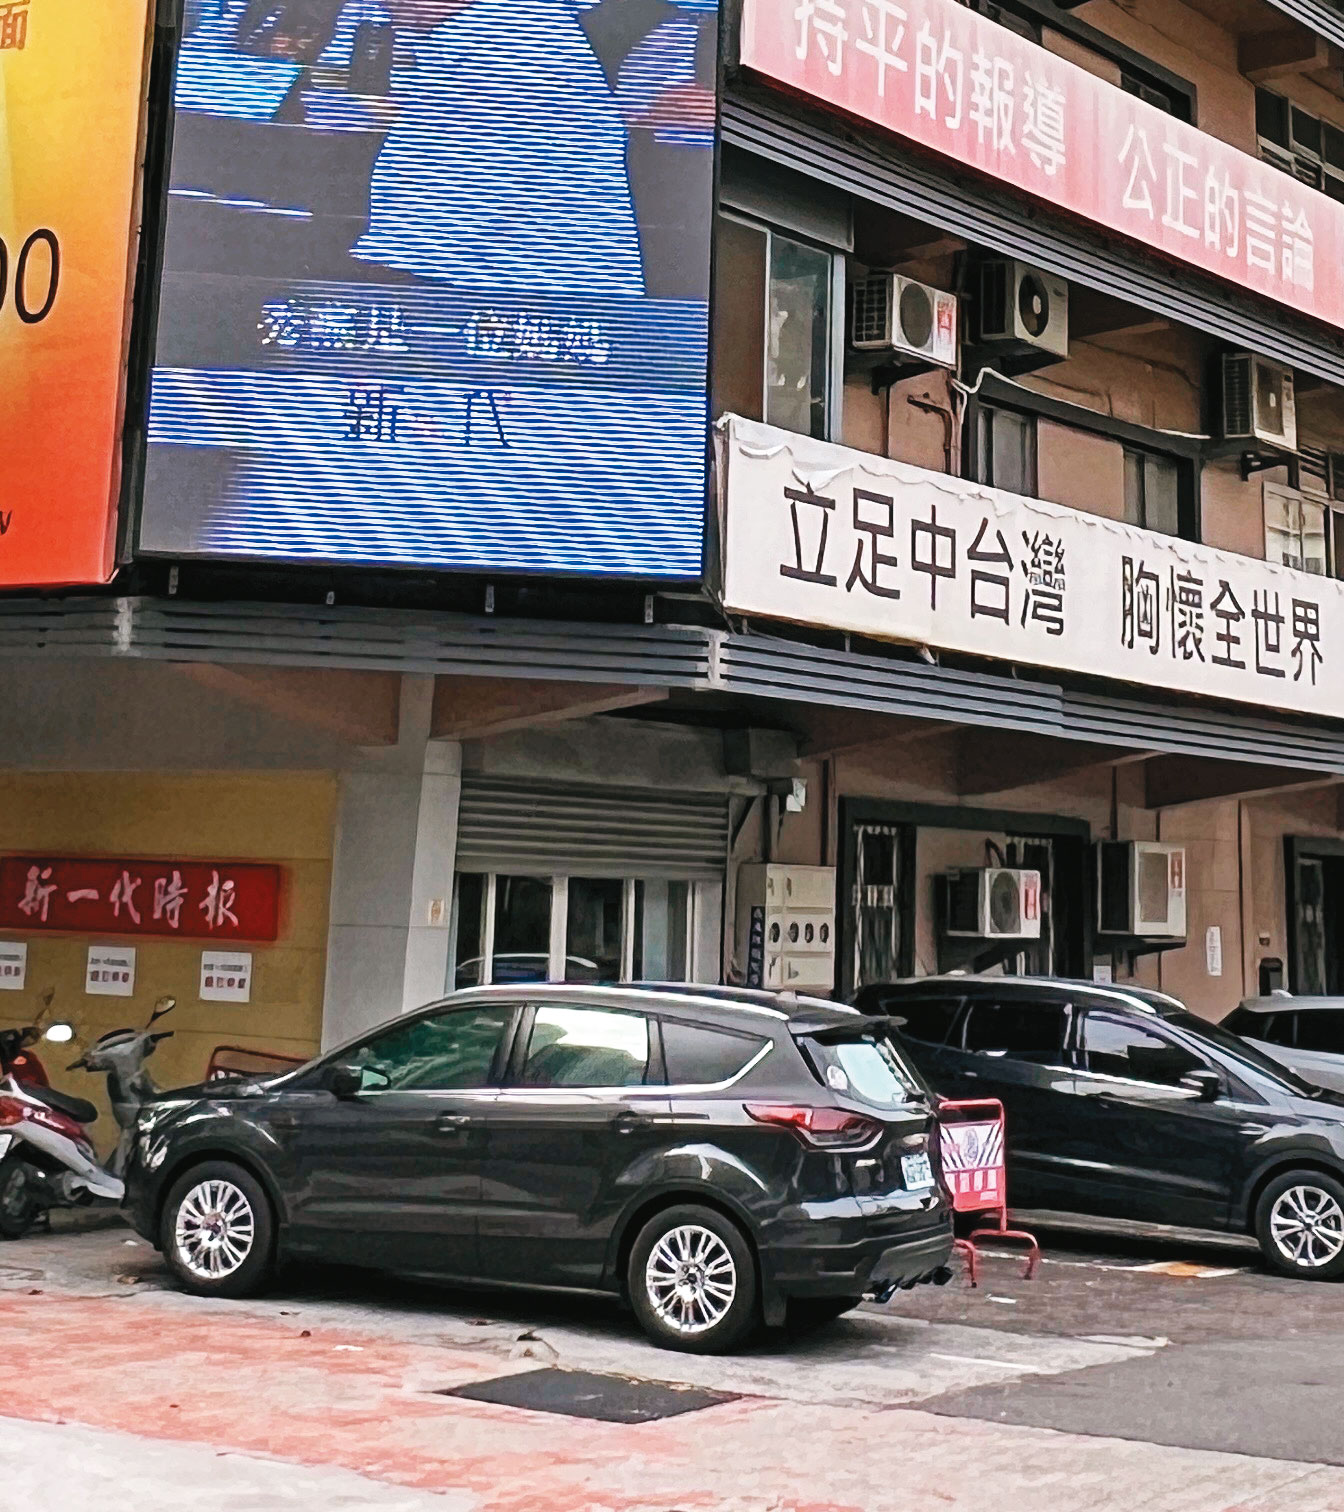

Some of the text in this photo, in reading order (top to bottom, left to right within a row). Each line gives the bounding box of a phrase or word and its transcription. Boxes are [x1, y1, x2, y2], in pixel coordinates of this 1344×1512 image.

[1116, 122, 1315, 294] 公正的言論
[778, 481, 1067, 638] 立足中台灣
[1121, 554, 1324, 687] 胸懷全世界
